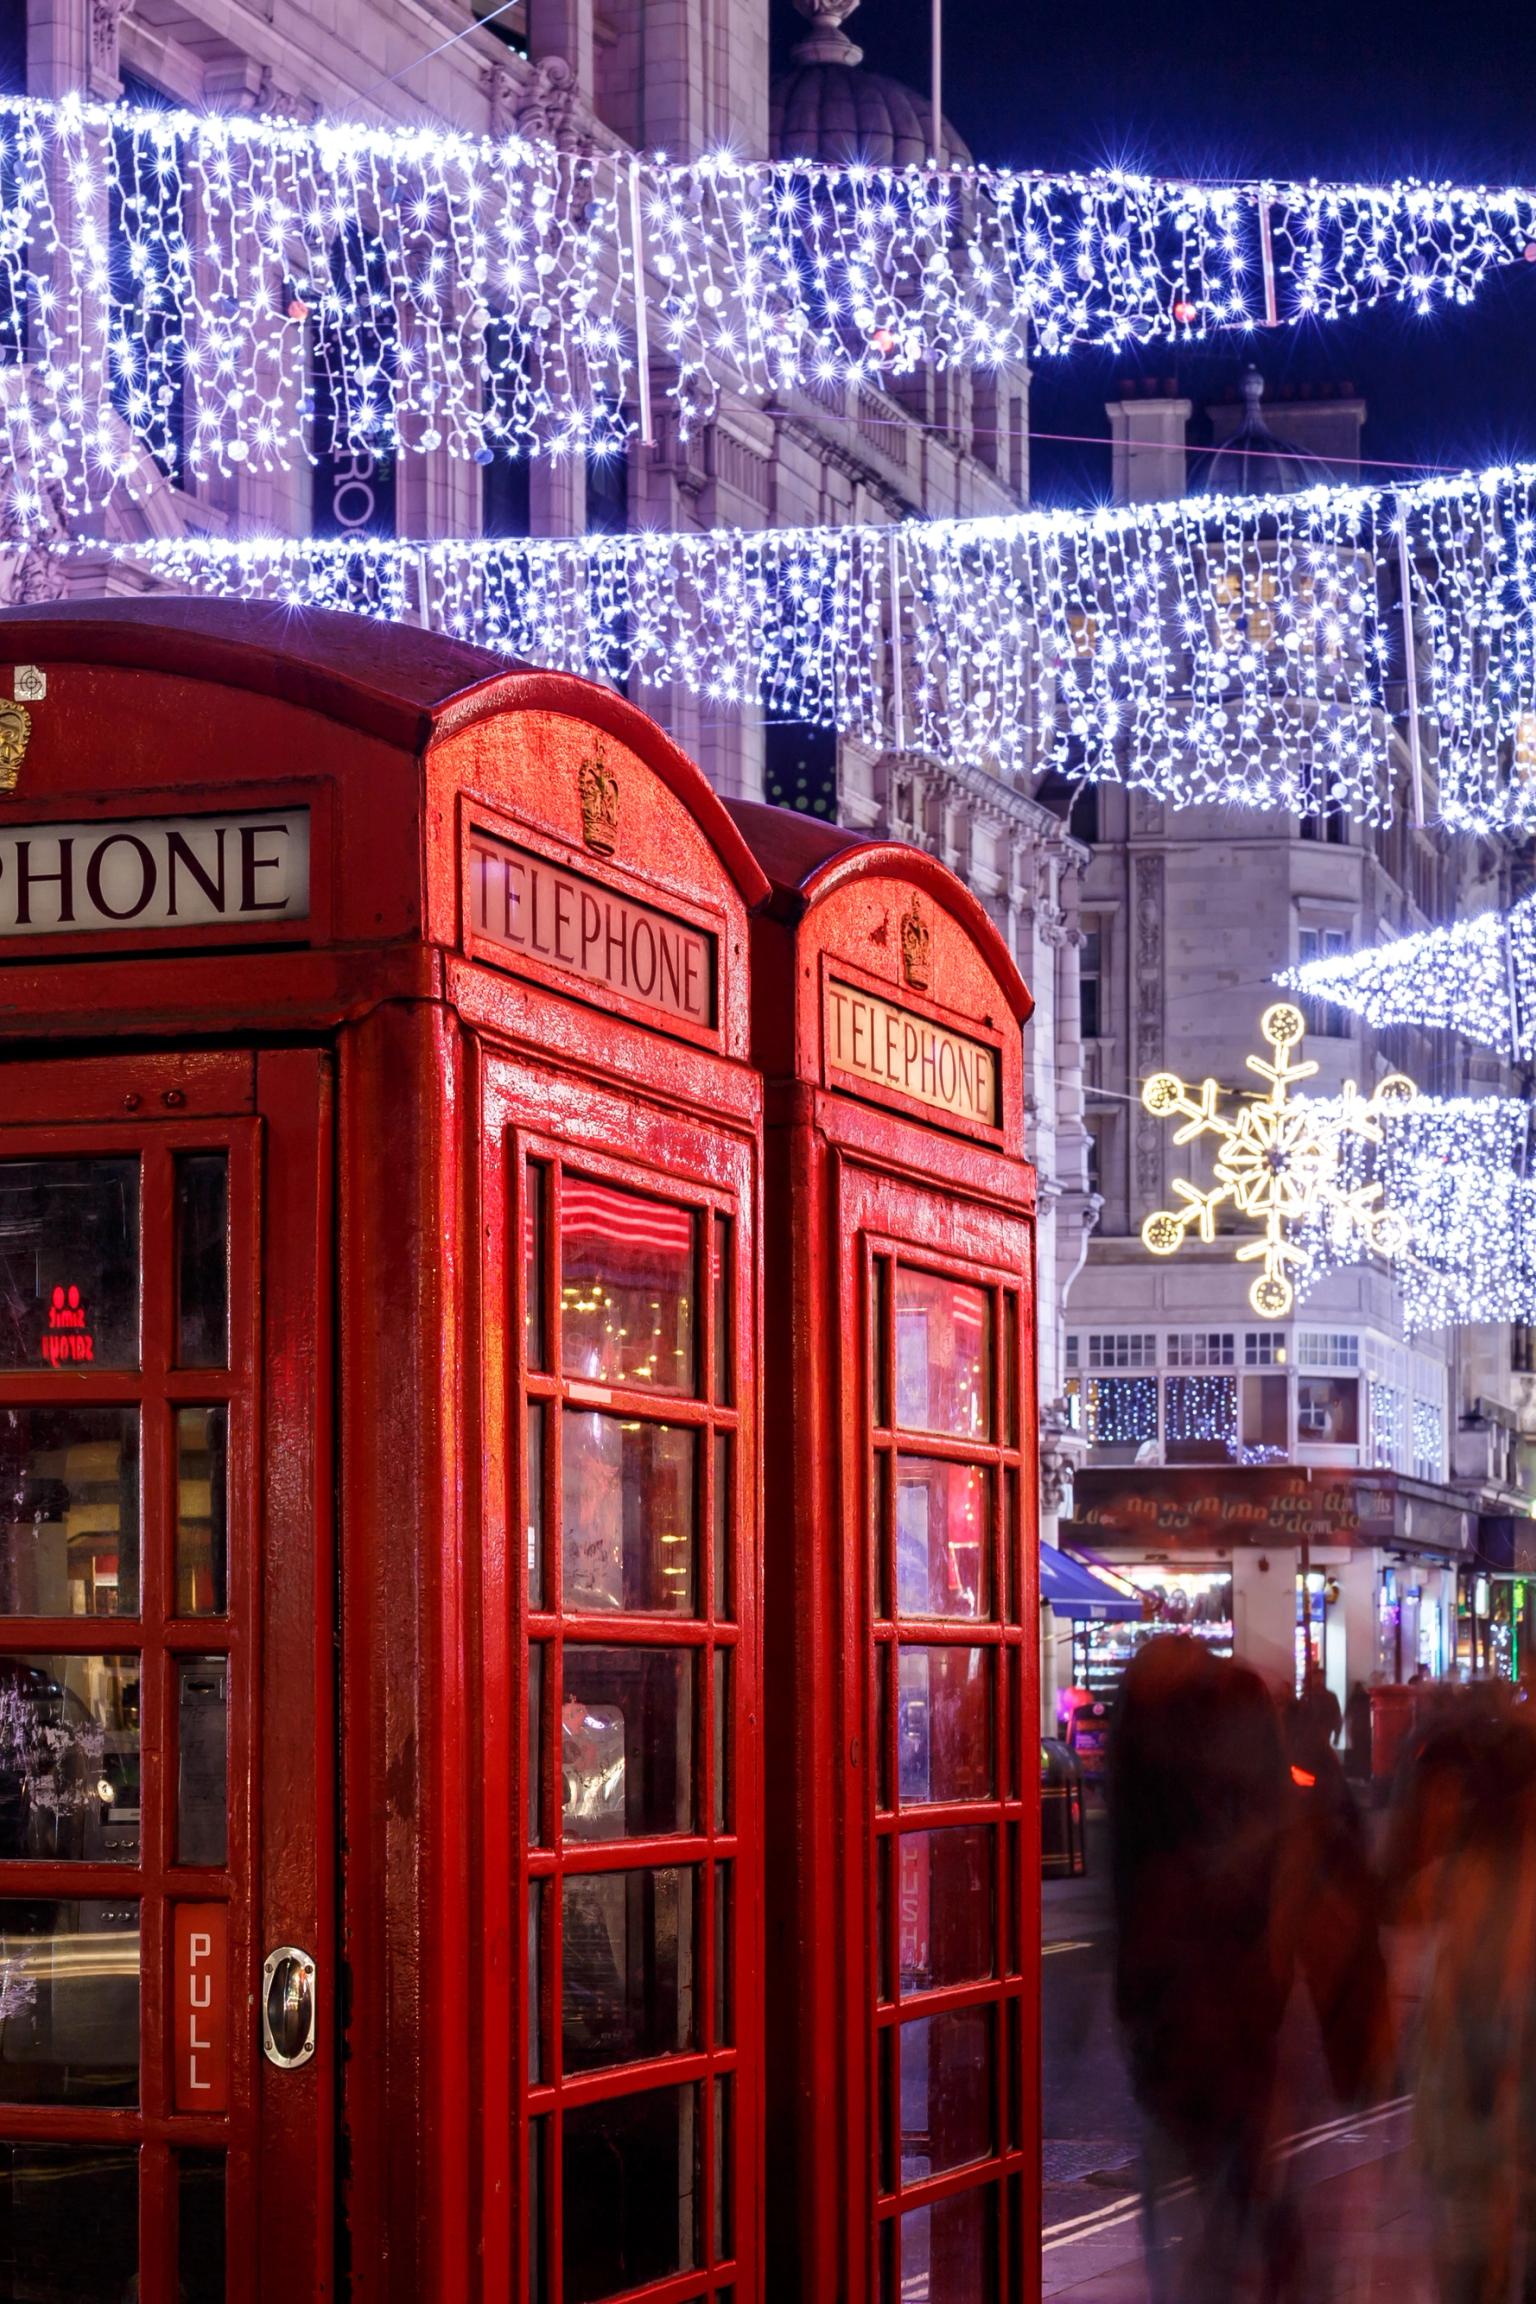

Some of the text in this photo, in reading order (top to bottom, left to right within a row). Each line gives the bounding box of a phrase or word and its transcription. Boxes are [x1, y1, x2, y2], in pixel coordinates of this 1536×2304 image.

[0, 824, 291, 925] HONE
[470, 843, 701, 1016] TELEPHONE
[830, 989, 988, 1117] TELEPHONE
[190, 1932, 211, 2089] PULL
